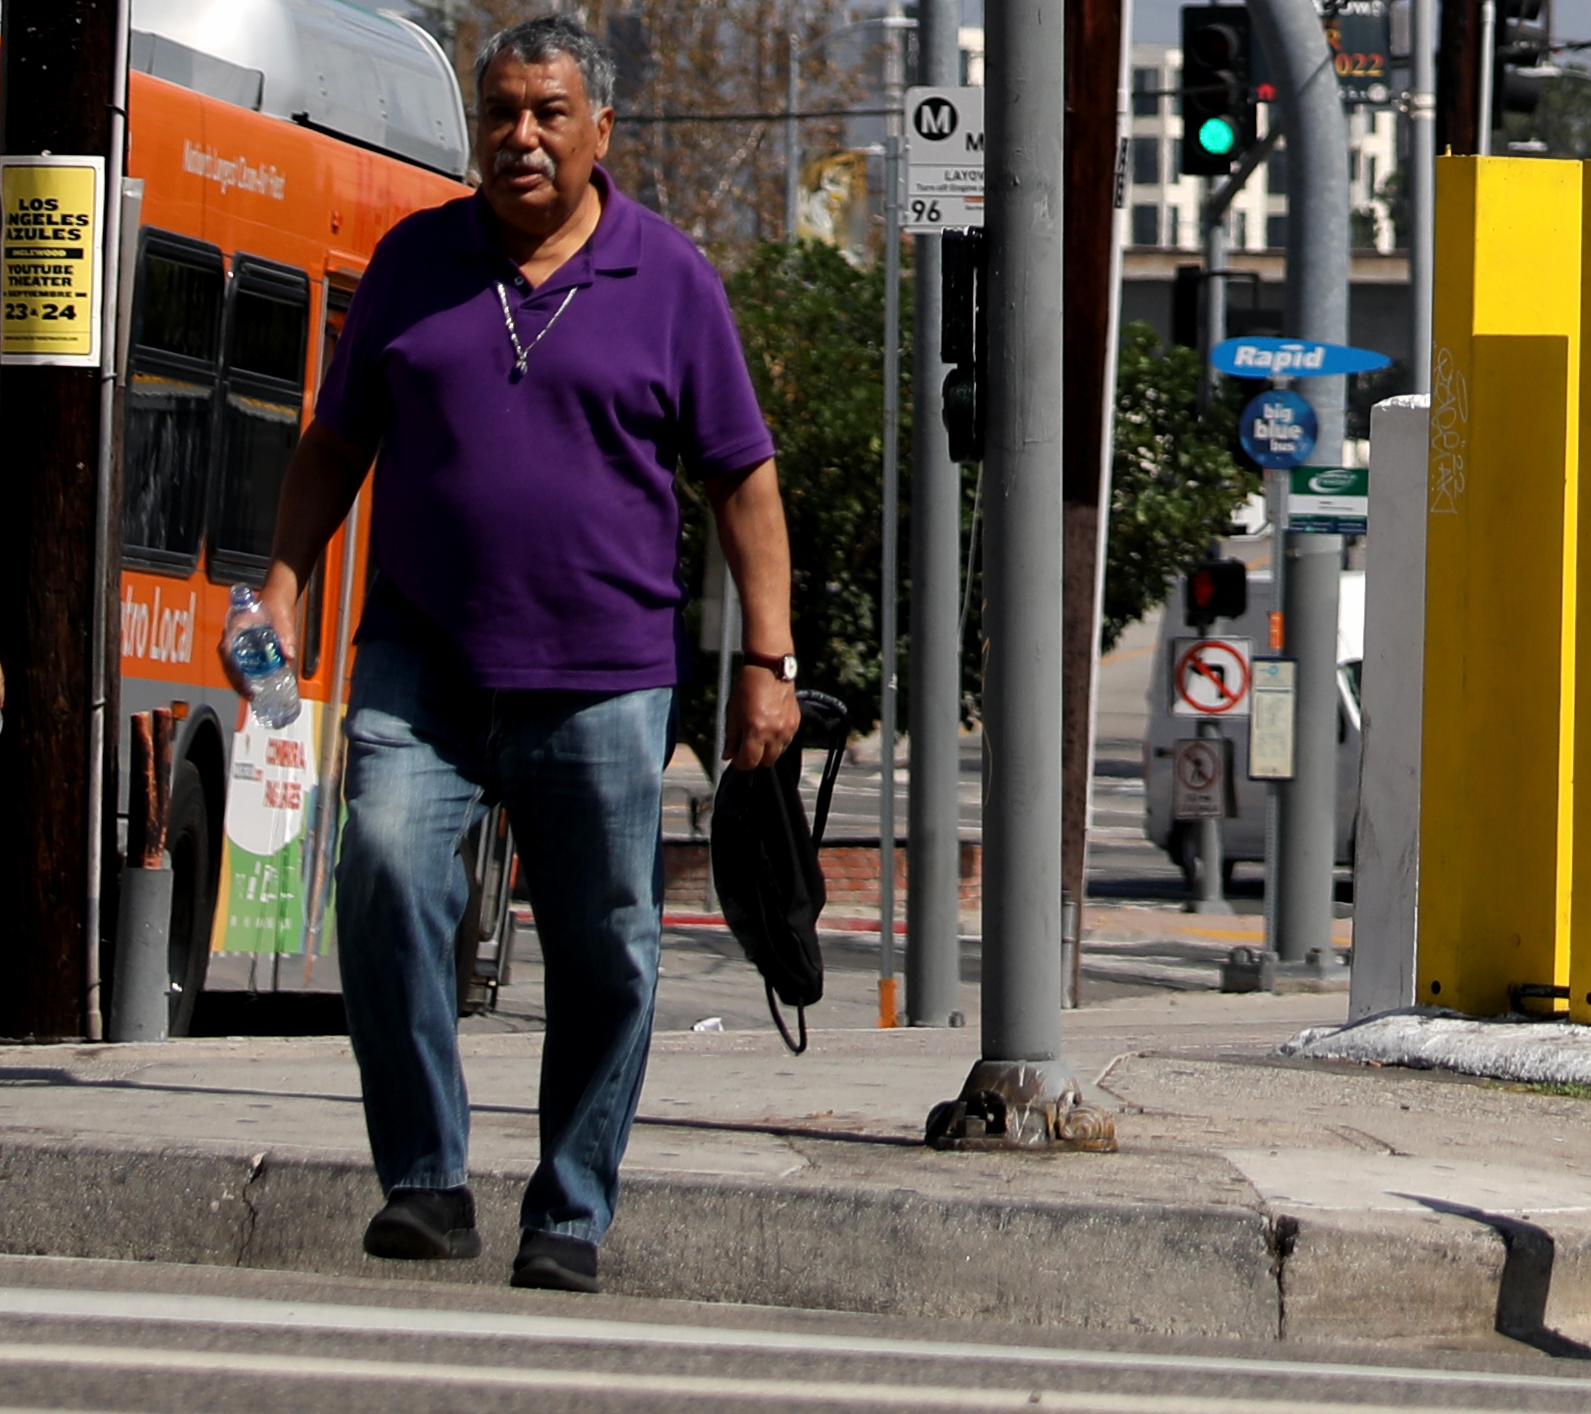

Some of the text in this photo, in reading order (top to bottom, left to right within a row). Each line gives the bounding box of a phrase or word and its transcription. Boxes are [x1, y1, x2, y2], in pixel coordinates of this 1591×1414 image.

[1335, 52, 1385, 77] 022
[18, 198, 59, 211] LOS
[911, 200, 942, 223] 96
[8, 213, 89, 227] NGELES
[7, 264, 75, 275] YOUTUBE
[8, 276, 72, 287] THEATER
[4, 302, 28, 320] 23
[41, 303, 76, 320] 24
[1233, 344, 1327, 372] Rapid
[1263, 404, 1294, 422] big
[1253, 419, 1303, 440] blue
[1269, 439, 1296, 453] bus
[121, 585, 196, 664] tro Local
